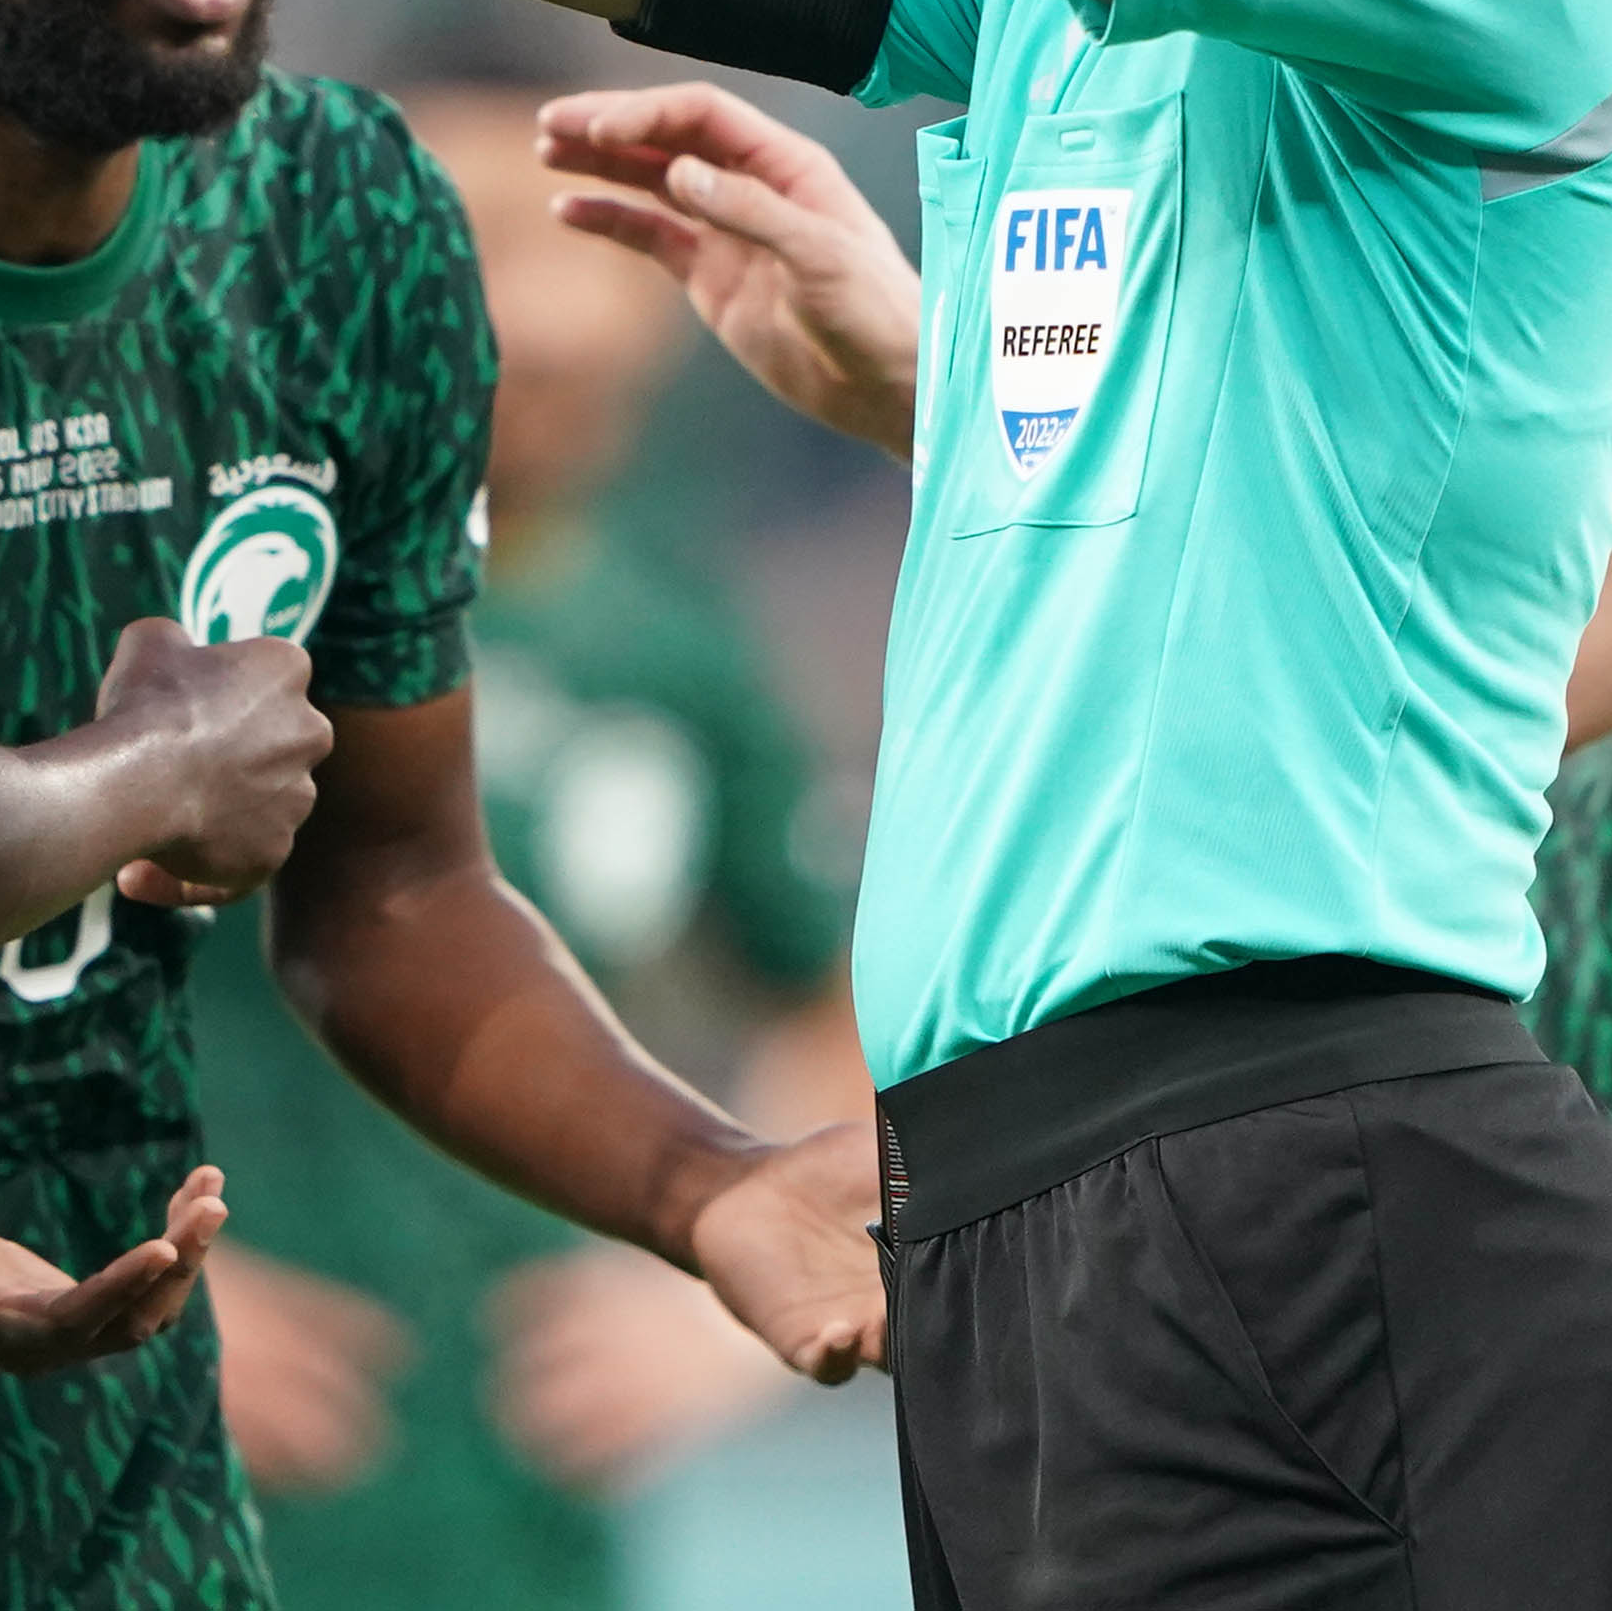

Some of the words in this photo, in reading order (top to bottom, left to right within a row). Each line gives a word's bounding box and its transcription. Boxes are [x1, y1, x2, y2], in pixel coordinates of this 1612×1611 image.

[1005, 206, 1108, 272] FIFA
[1002, 323, 1102, 357] REFEREE
[63, 412, 111, 449] KSA
[58, 445, 121, 486] 2022
